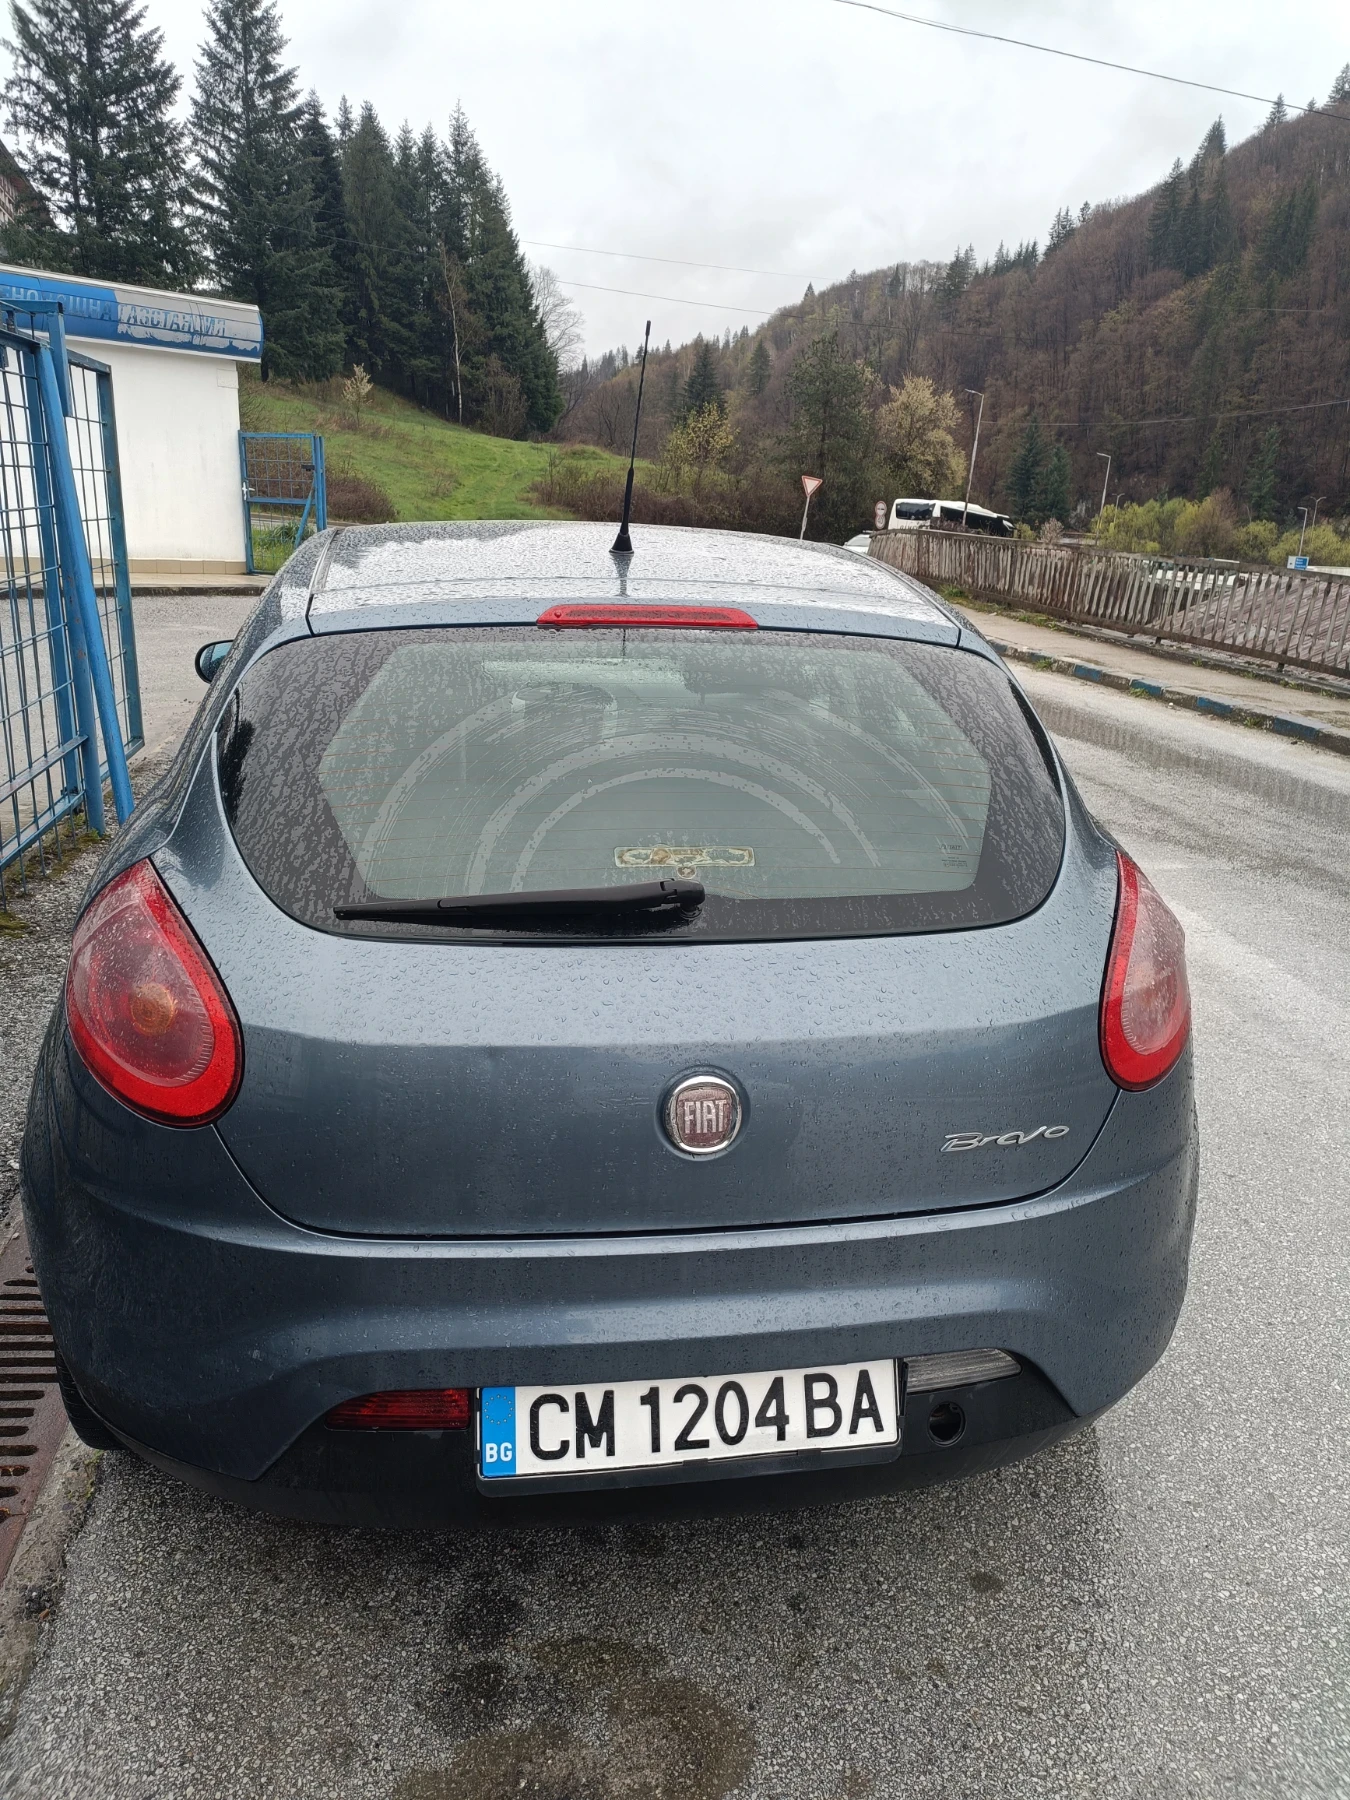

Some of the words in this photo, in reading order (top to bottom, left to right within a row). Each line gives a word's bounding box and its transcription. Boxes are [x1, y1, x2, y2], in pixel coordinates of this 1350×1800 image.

[684, 1099, 727, 1134] FIAT
[939, 1125, 1070, 1153] Bravo
[529, 1389, 616, 1461] CM
[640, 1376, 790, 1453] 1204
[803, 1369, 885, 1439] BA
[485, 1441, 514, 1464] BG
